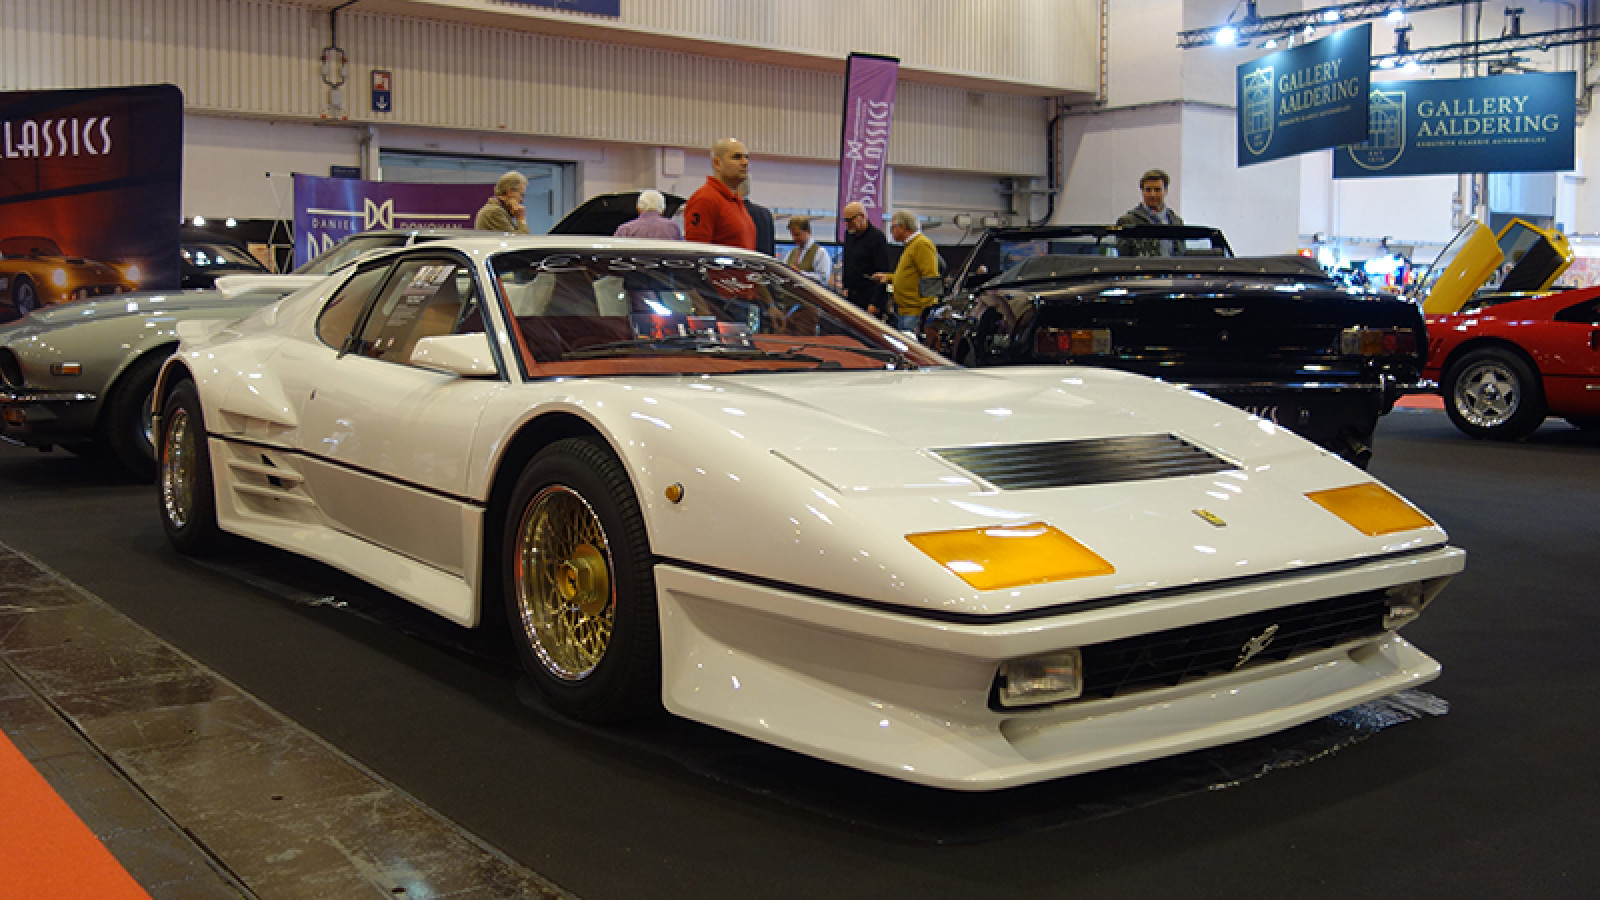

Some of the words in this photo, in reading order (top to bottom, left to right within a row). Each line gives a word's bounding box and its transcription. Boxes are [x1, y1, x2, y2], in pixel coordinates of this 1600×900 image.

[1278, 58, 1342, 93] GALLERY
[1279, 77, 1359, 116] AALDERING
[1417, 95, 1529, 118] GALLERY
[0, 116, 111, 159] LASSICS
[1416, 113, 1559, 137] AALDERING
